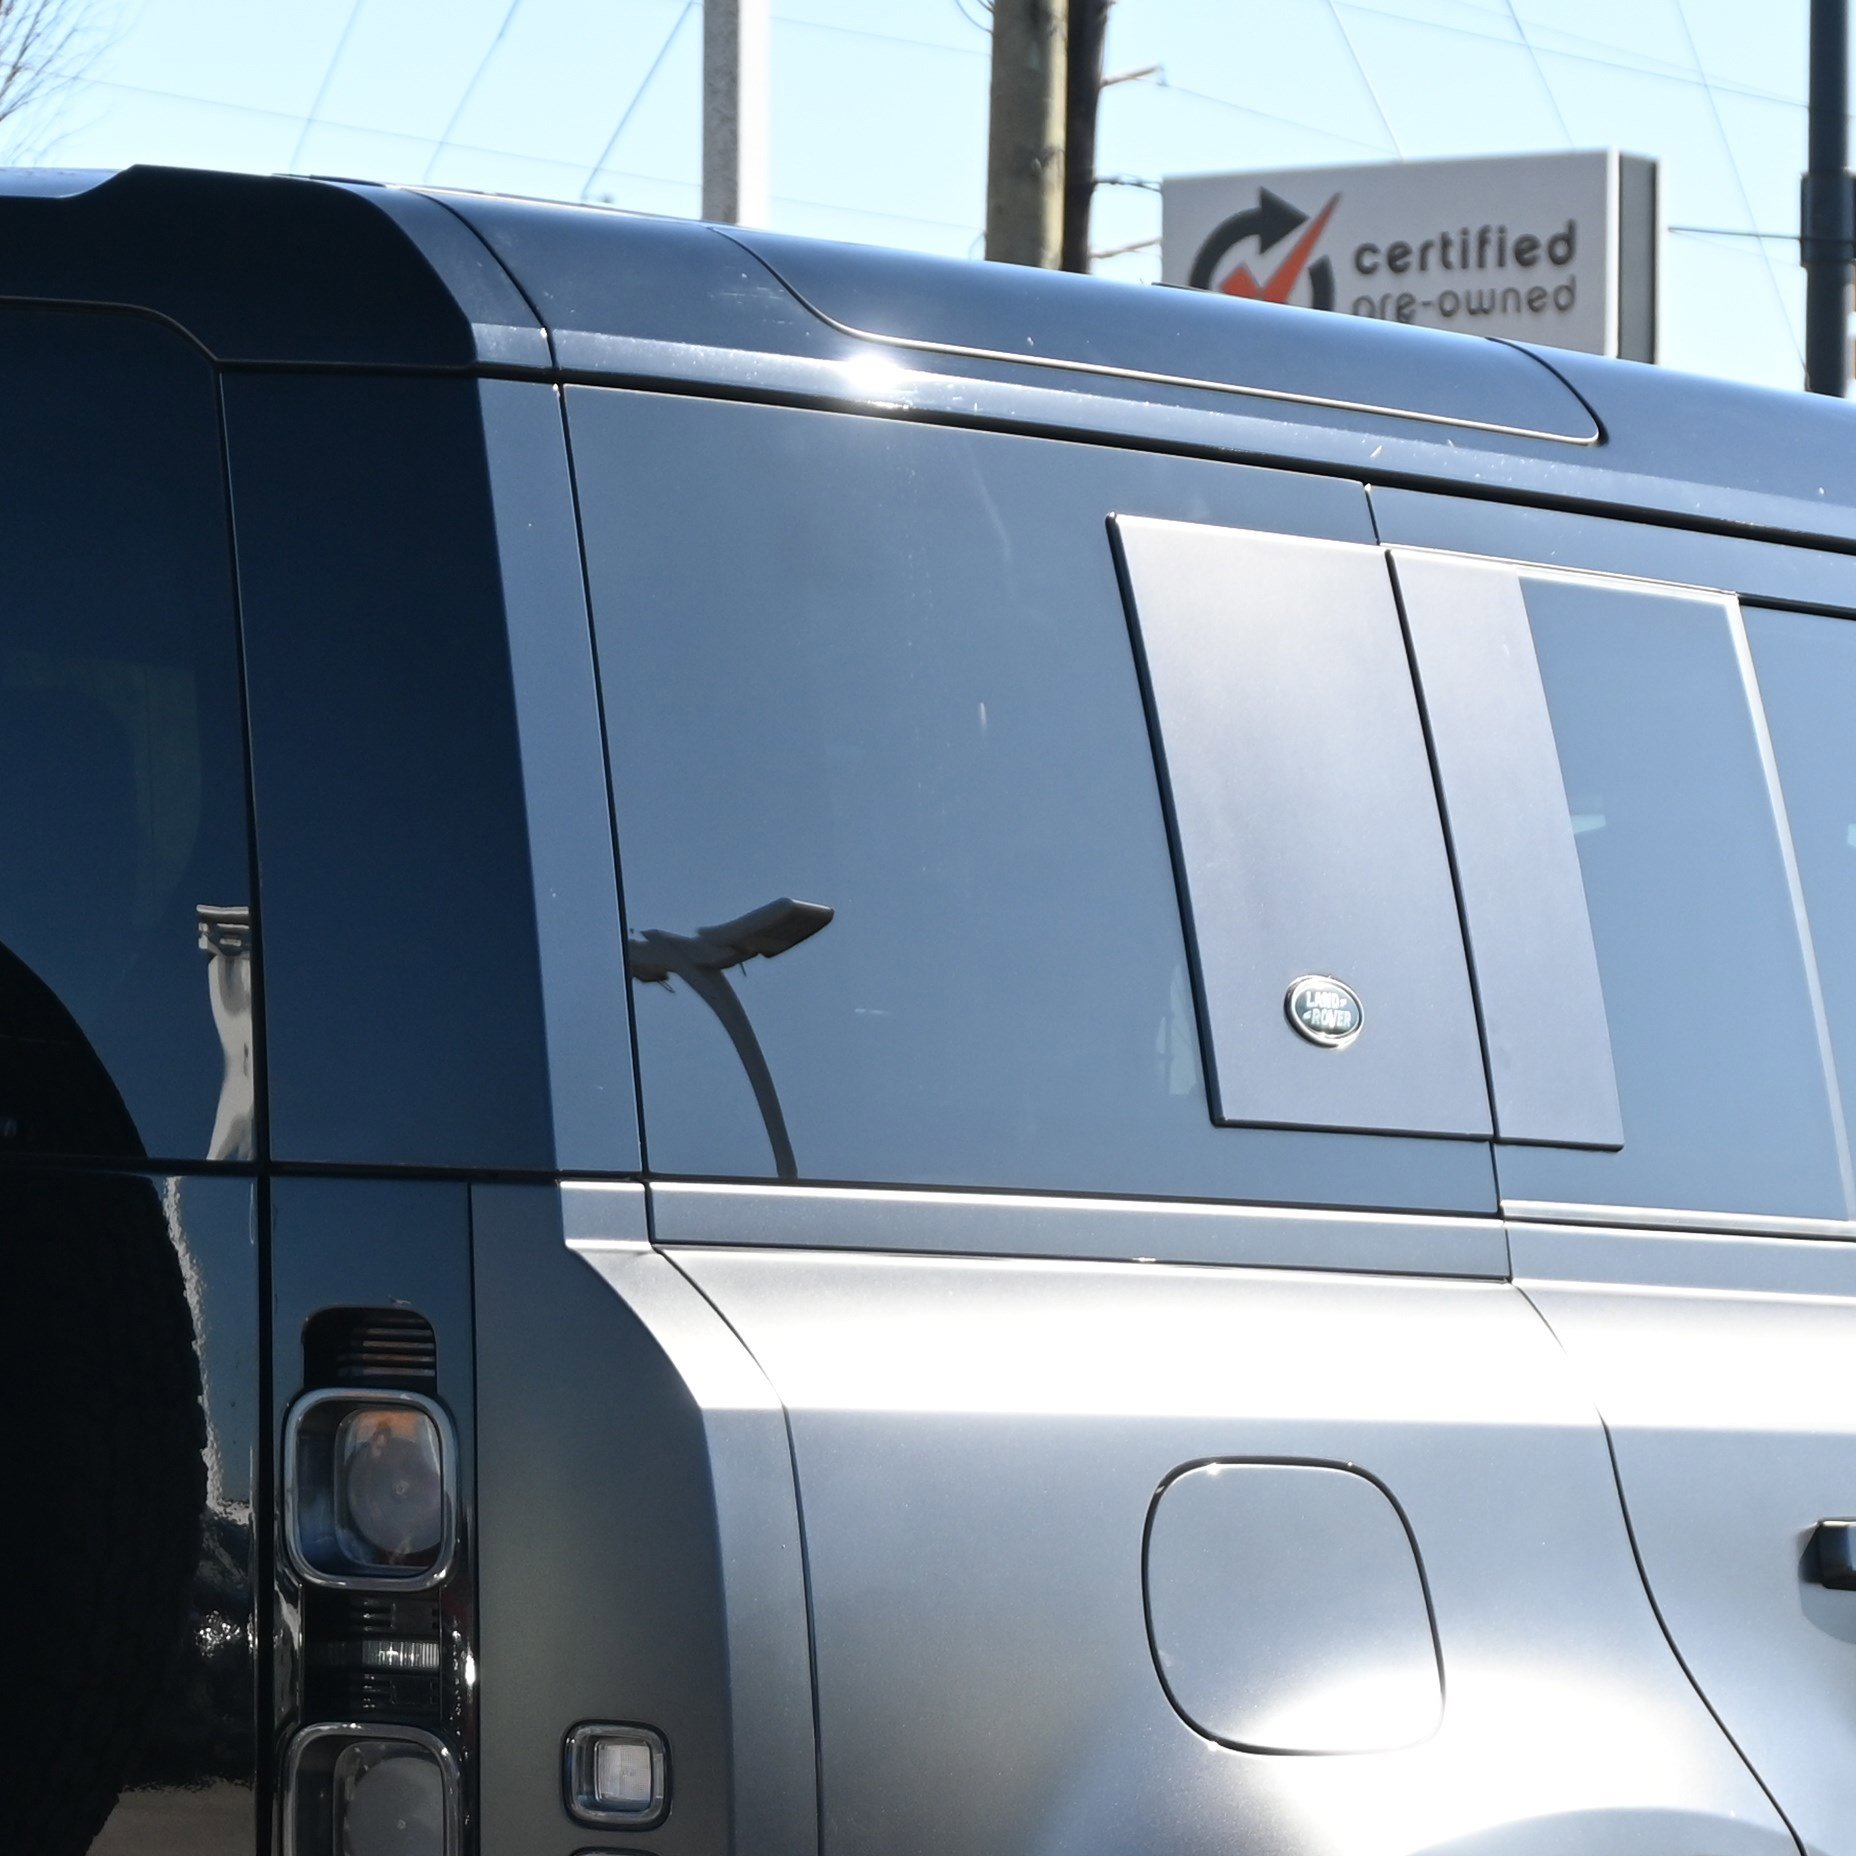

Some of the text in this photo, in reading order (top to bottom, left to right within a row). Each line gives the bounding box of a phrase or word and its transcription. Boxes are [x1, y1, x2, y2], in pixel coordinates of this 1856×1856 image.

[1353, 218, 1577, 276] certified
[1306, 990, 1340, 1008] LAND
[1310, 1008, 1352, 1028] ROVER
